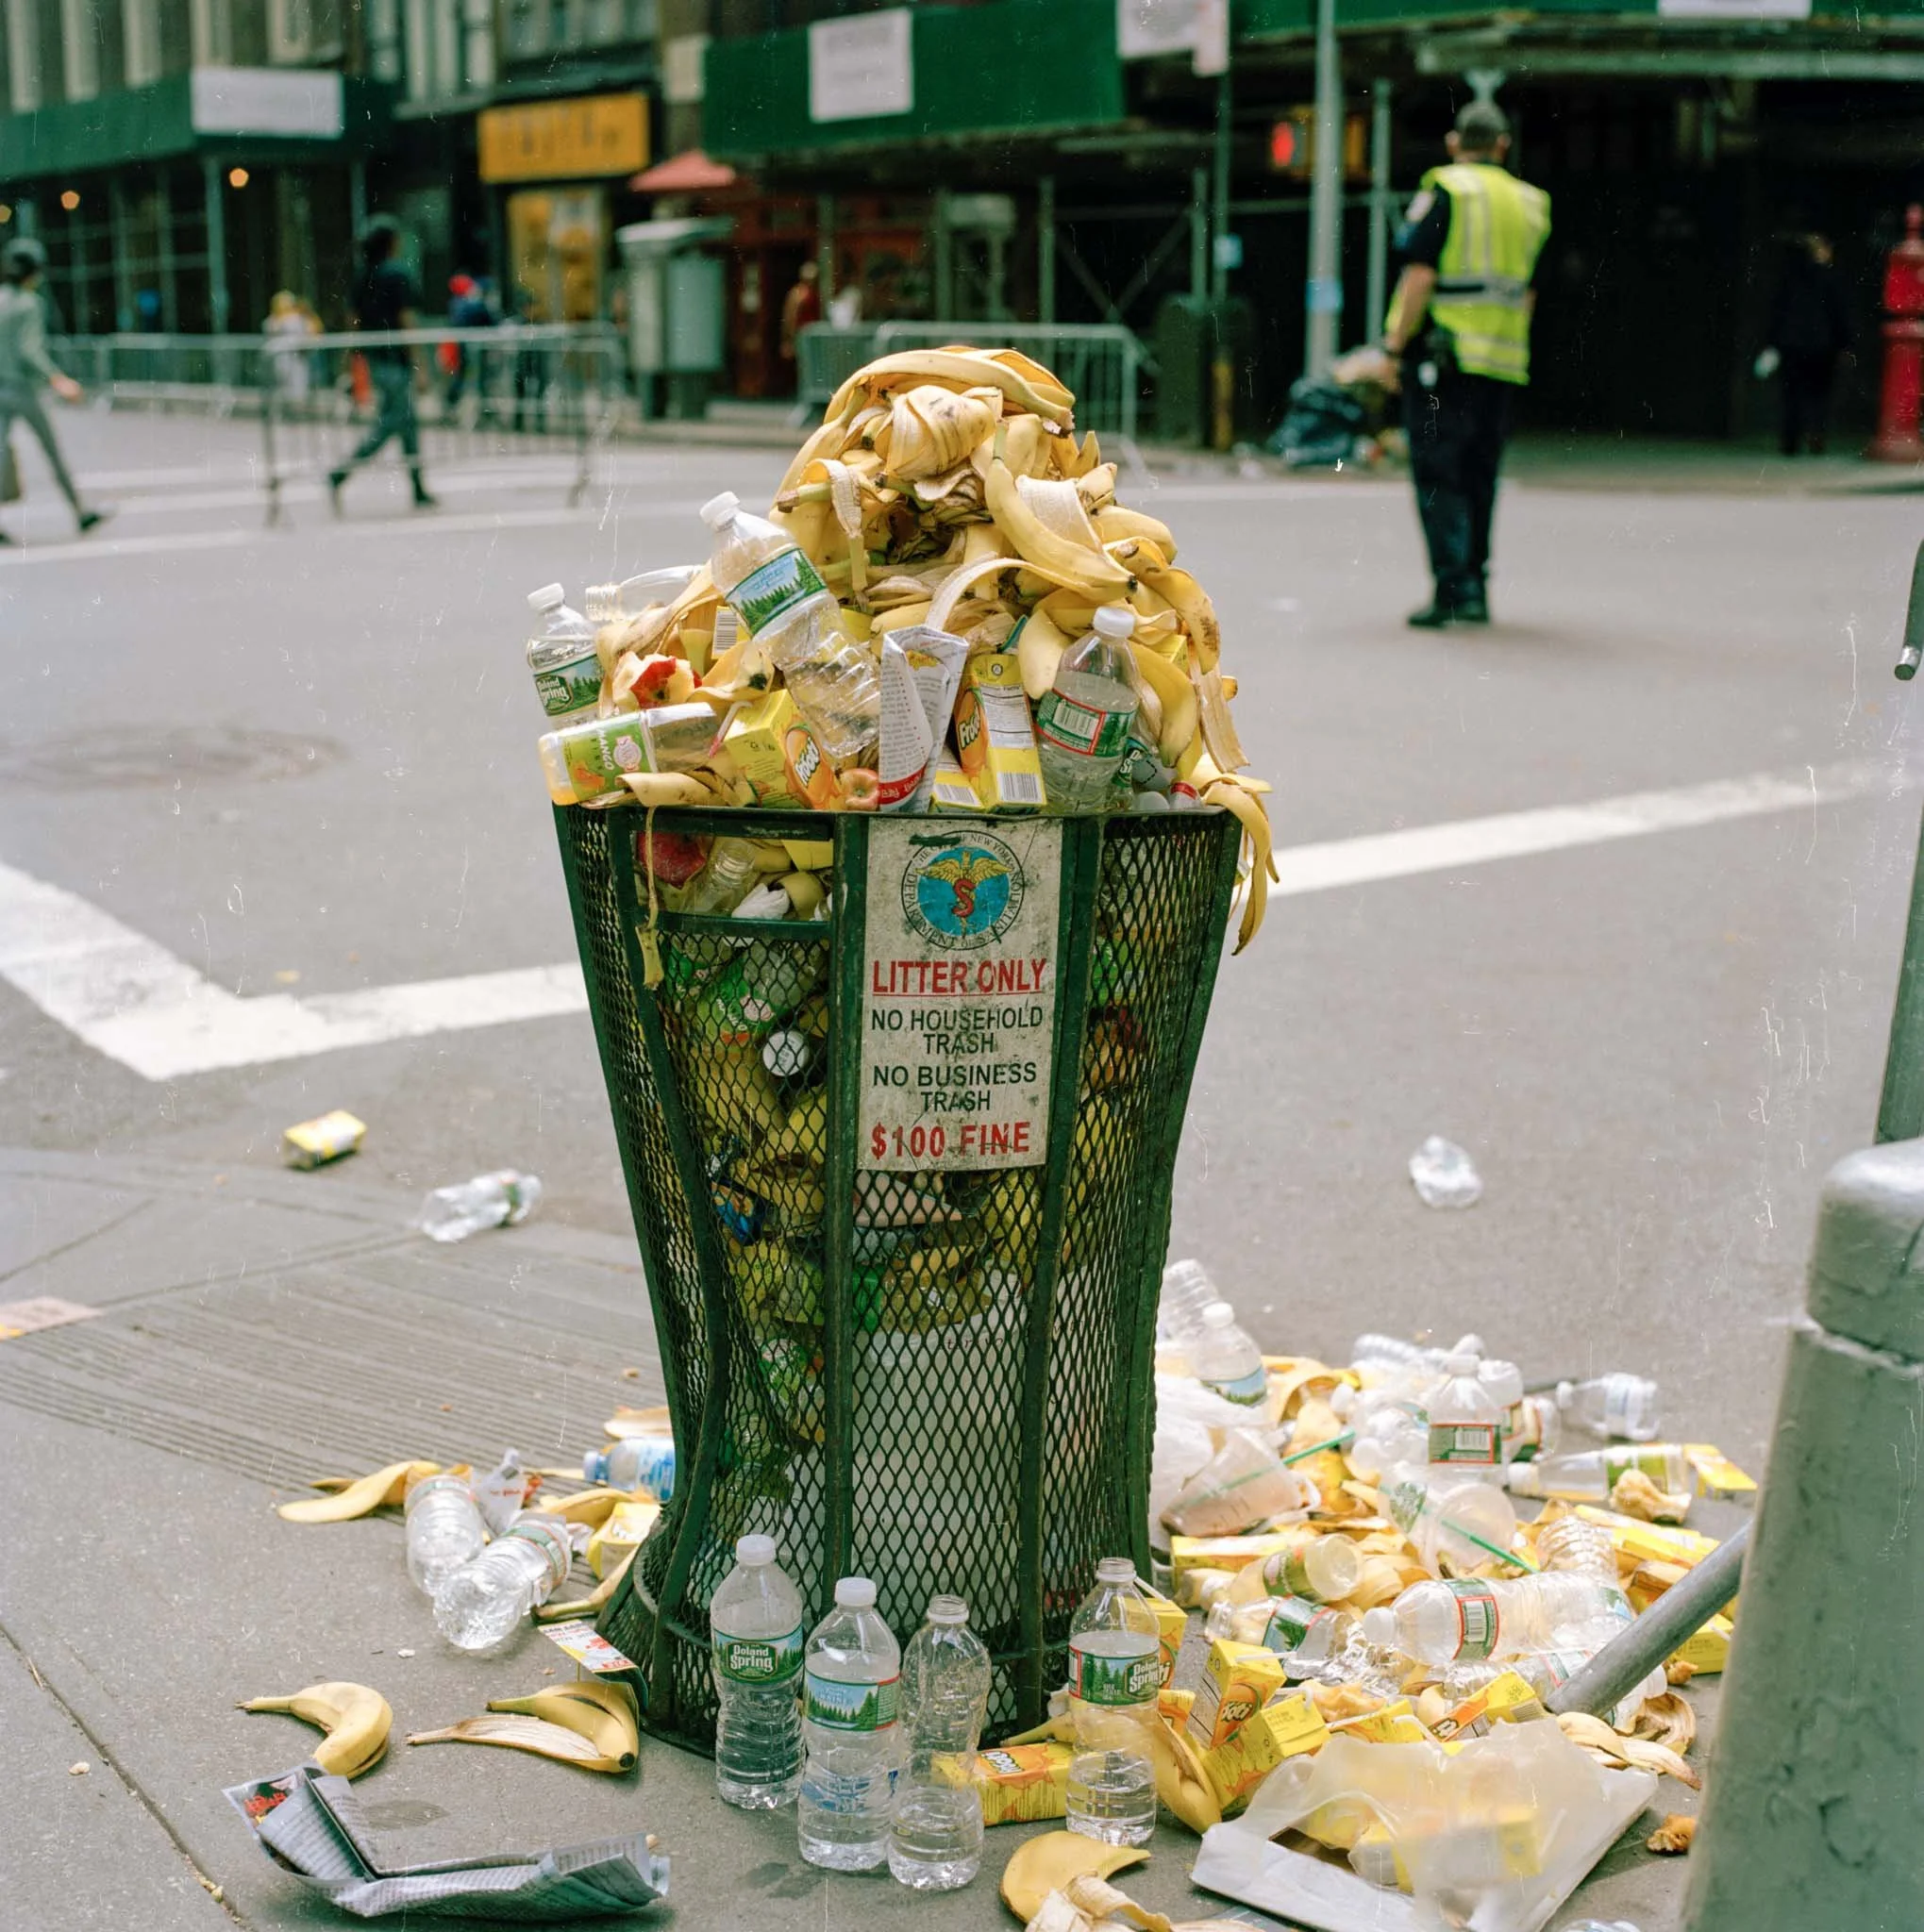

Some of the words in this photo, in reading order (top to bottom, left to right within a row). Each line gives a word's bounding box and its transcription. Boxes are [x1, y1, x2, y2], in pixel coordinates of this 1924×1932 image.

[596, 728, 616, 771] MANGO
[971, 833, 994, 847] NEW
[872, 959, 969, 993] LITTER
[977, 958, 1047, 993] ONLY
[871, 1008, 904, 1031] NO
[911, 1006, 1044, 1031] HOUSEHOLD
[923, 1033, 995, 1056] TRASH
[873, 1065, 910, 1087] NO
[917, 1061, 1037, 1087] BUSINESS
[921, 1091, 991, 1113] TRASH
[870, 1122, 945, 1160] $100
[960, 1121, 1031, 1157] FINE
[733, 1644, 769, 1657] Poland
[730, 1655, 774, 1673] Spring
